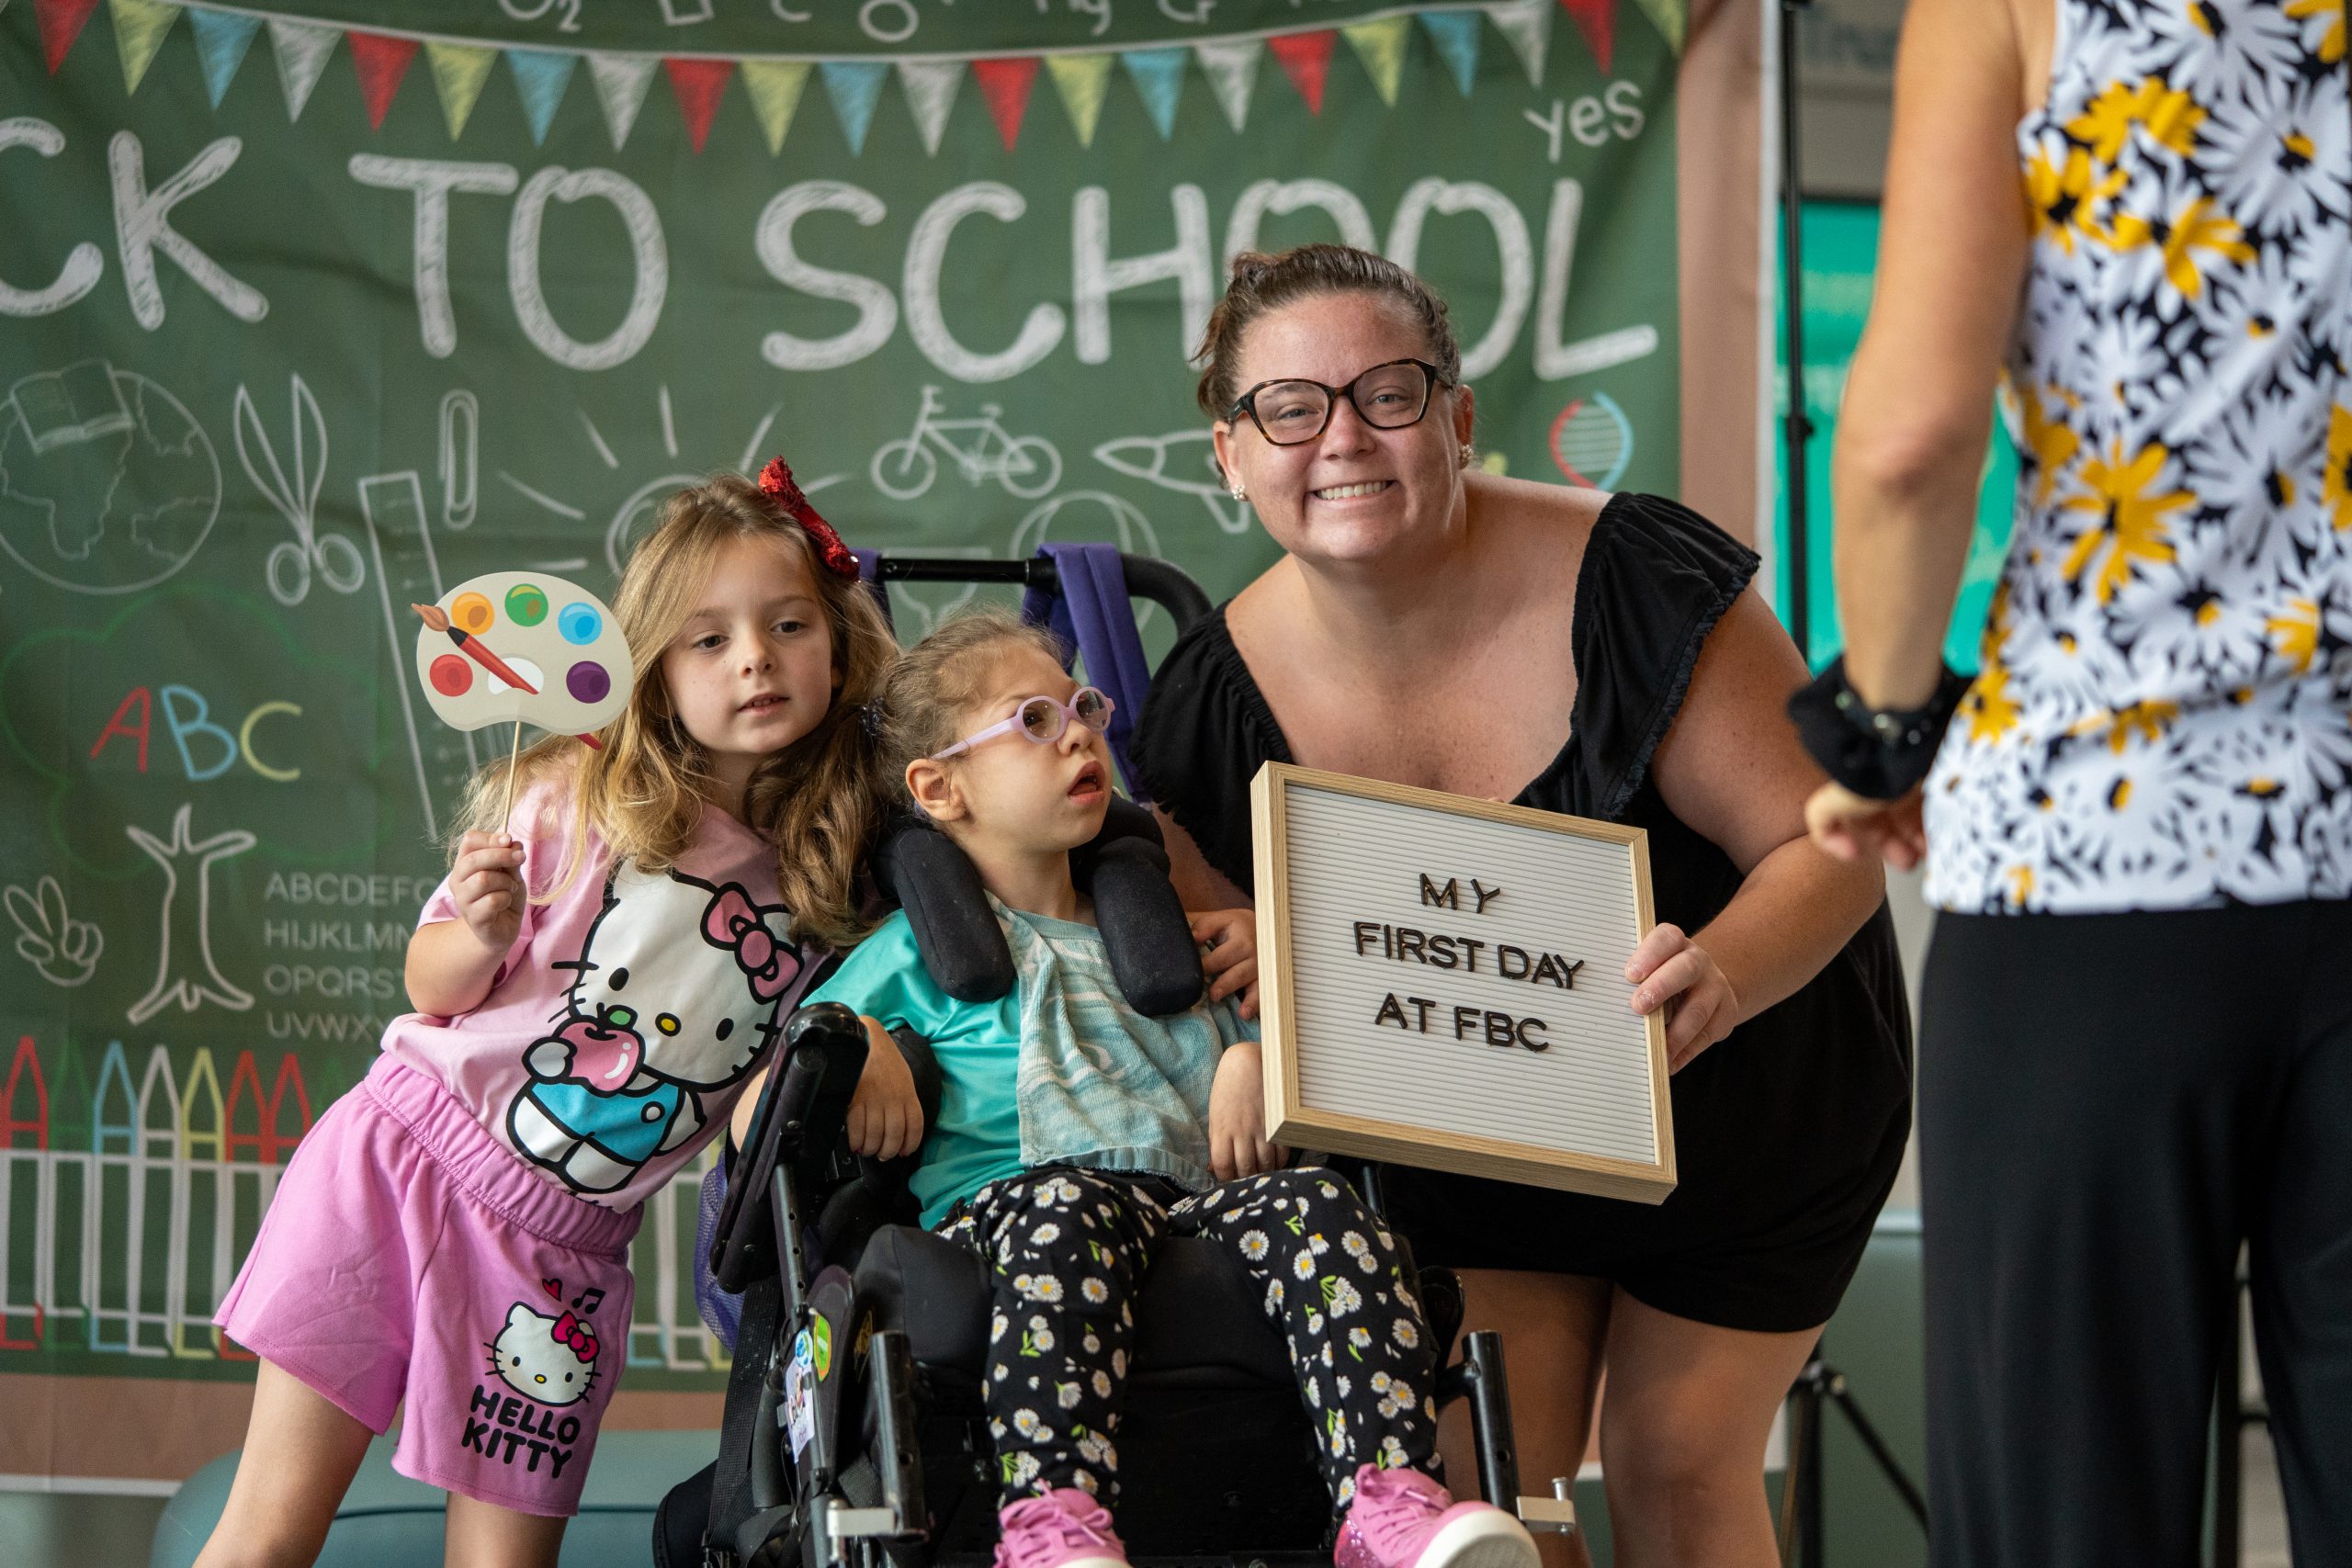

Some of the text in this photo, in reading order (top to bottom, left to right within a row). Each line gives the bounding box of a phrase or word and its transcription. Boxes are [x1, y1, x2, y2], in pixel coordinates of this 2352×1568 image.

[1522, 79, 1645, 164] yes
[349, 152, 669, 371] TO
[91, 684, 302, 782] ABC
[1419, 873, 1500, 914] MY
[264, 964, 405, 999] OPQRS
[1353, 921, 1585, 990] FIRST DAY
[1374, 992, 1550, 1054] AT FBC
[470, 1384, 581, 1445] HELLO
[461, 1416, 572, 1479] KITTY
